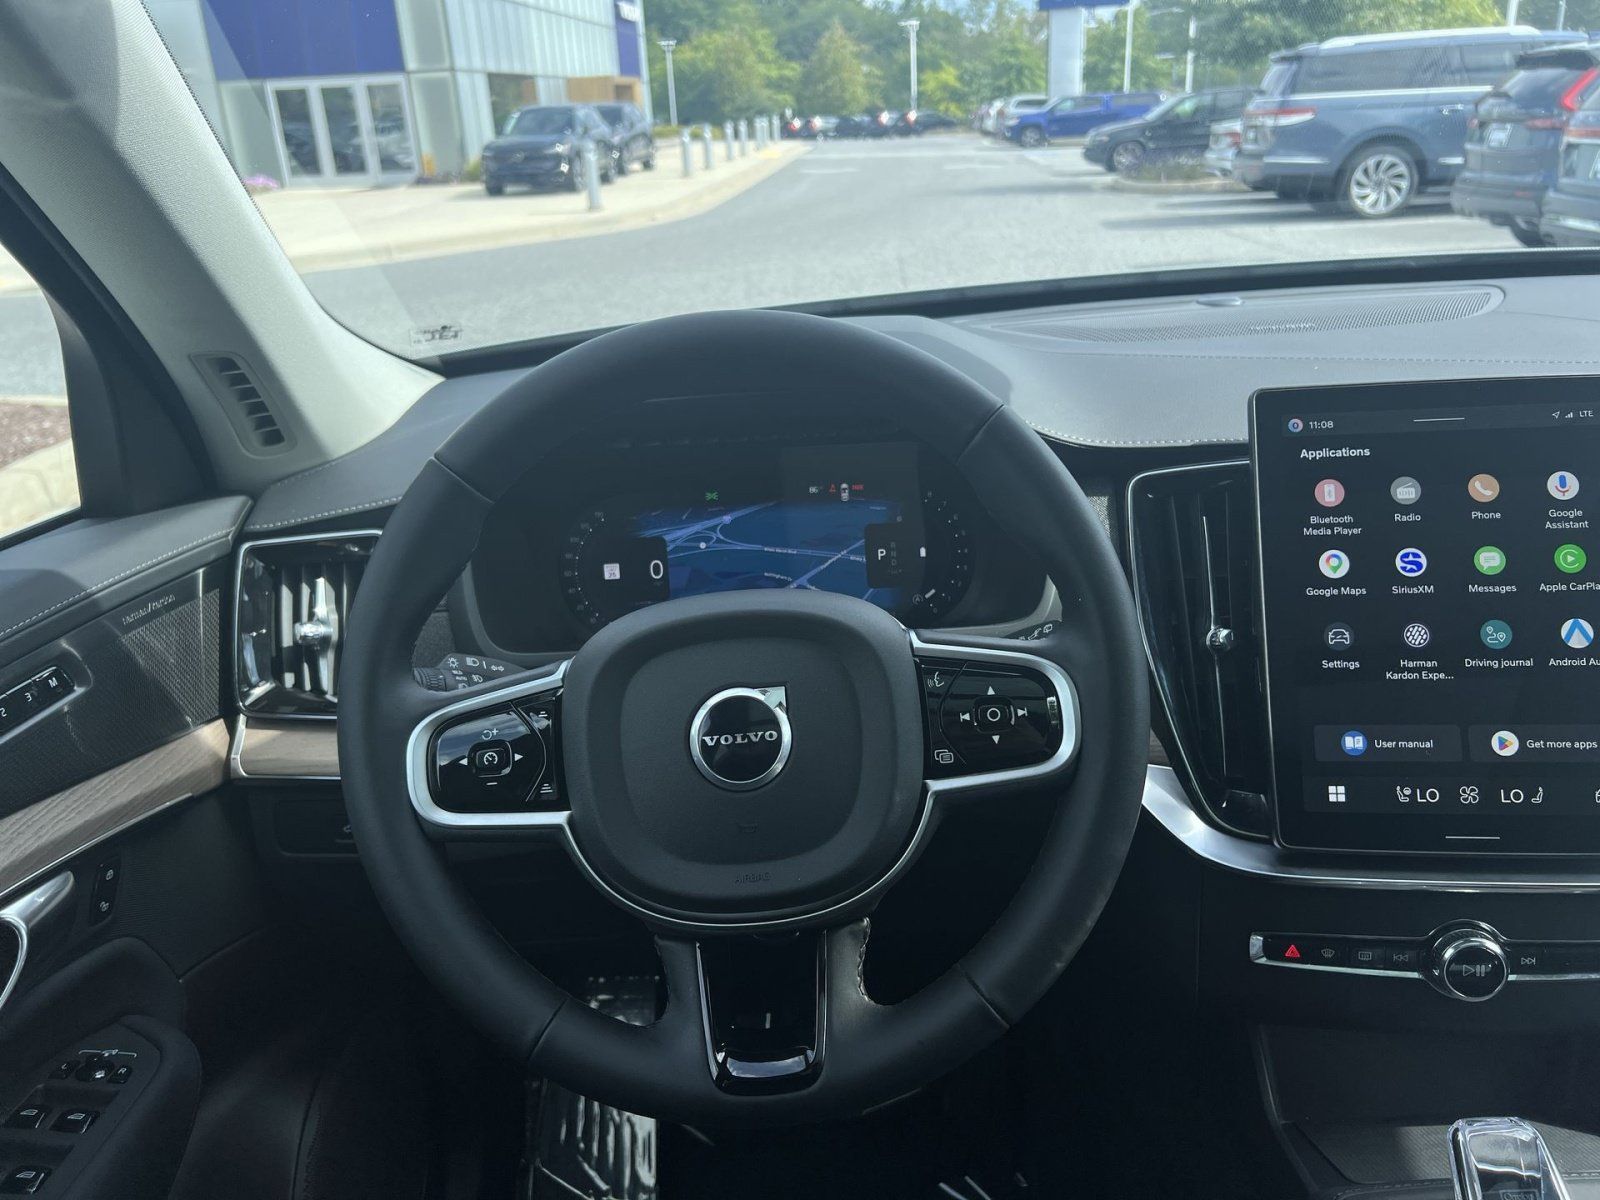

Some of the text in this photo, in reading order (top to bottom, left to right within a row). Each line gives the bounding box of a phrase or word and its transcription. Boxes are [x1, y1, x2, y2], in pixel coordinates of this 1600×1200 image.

[1579, 410, 1594, 418] LTE
[1308, 420, 1334, 429] 11:08
[1300, 446, 1371, 461] Applications
[1309, 514, 1354, 524] Bluetooth
[1394, 512, 1422, 522] Radio
[1471, 511, 1502, 520] Phone
[1548, 508, 1583, 519] Google
[1544, 520, 1589, 529] Assistant
[1303, 526, 1362, 537] Media Player
[877, 548, 887, 561] P
[649, 559, 664, 580] 0
[1305, 586, 1367, 598] Google Maps
[1391, 584, 1435, 594] SiriusXM
[1468, 584, 1517, 594] Messages
[1539, 582, 1567, 593] Apple
[1321, 659, 1360, 670] Settings
[1400, 659, 1438, 668] Harman
[1464, 657, 1534, 669] Driving journal
[1548, 657, 1587, 667] Android
[1385, 670, 1454, 681] Kardon Expe...
[48, 676, 58, 688] M
[24, 692, 33, 702] 3
[701, 729, 779, 747] VOLVO
[1374, 739, 1434, 749] User manual
[1526, 739, 1598, 751] Get more apps
[1416, 788, 1440, 803] LO
[1500, 788, 1524, 804] LO
